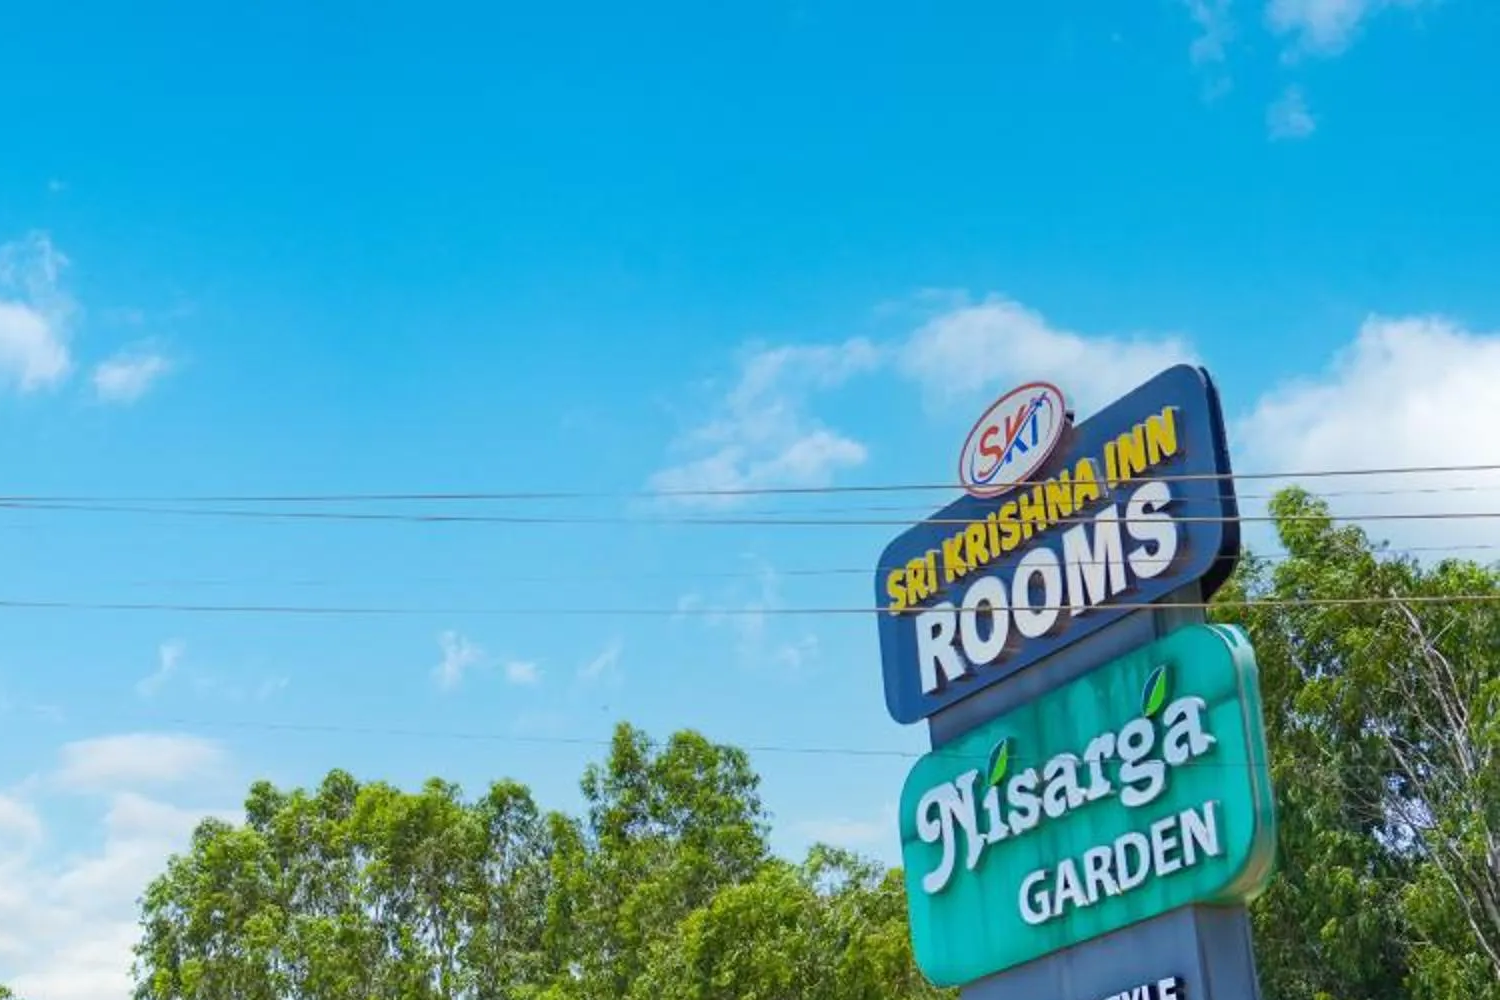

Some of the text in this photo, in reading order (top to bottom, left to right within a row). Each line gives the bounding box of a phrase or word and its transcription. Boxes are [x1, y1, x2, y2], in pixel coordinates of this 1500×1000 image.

[886, 406, 1178, 616] SRI KRISHNA INN
[915, 481, 1178, 694] ROOMS
[916, 696, 1216, 894] Nisarga
[1018, 800, 1220, 925] GARDEN
